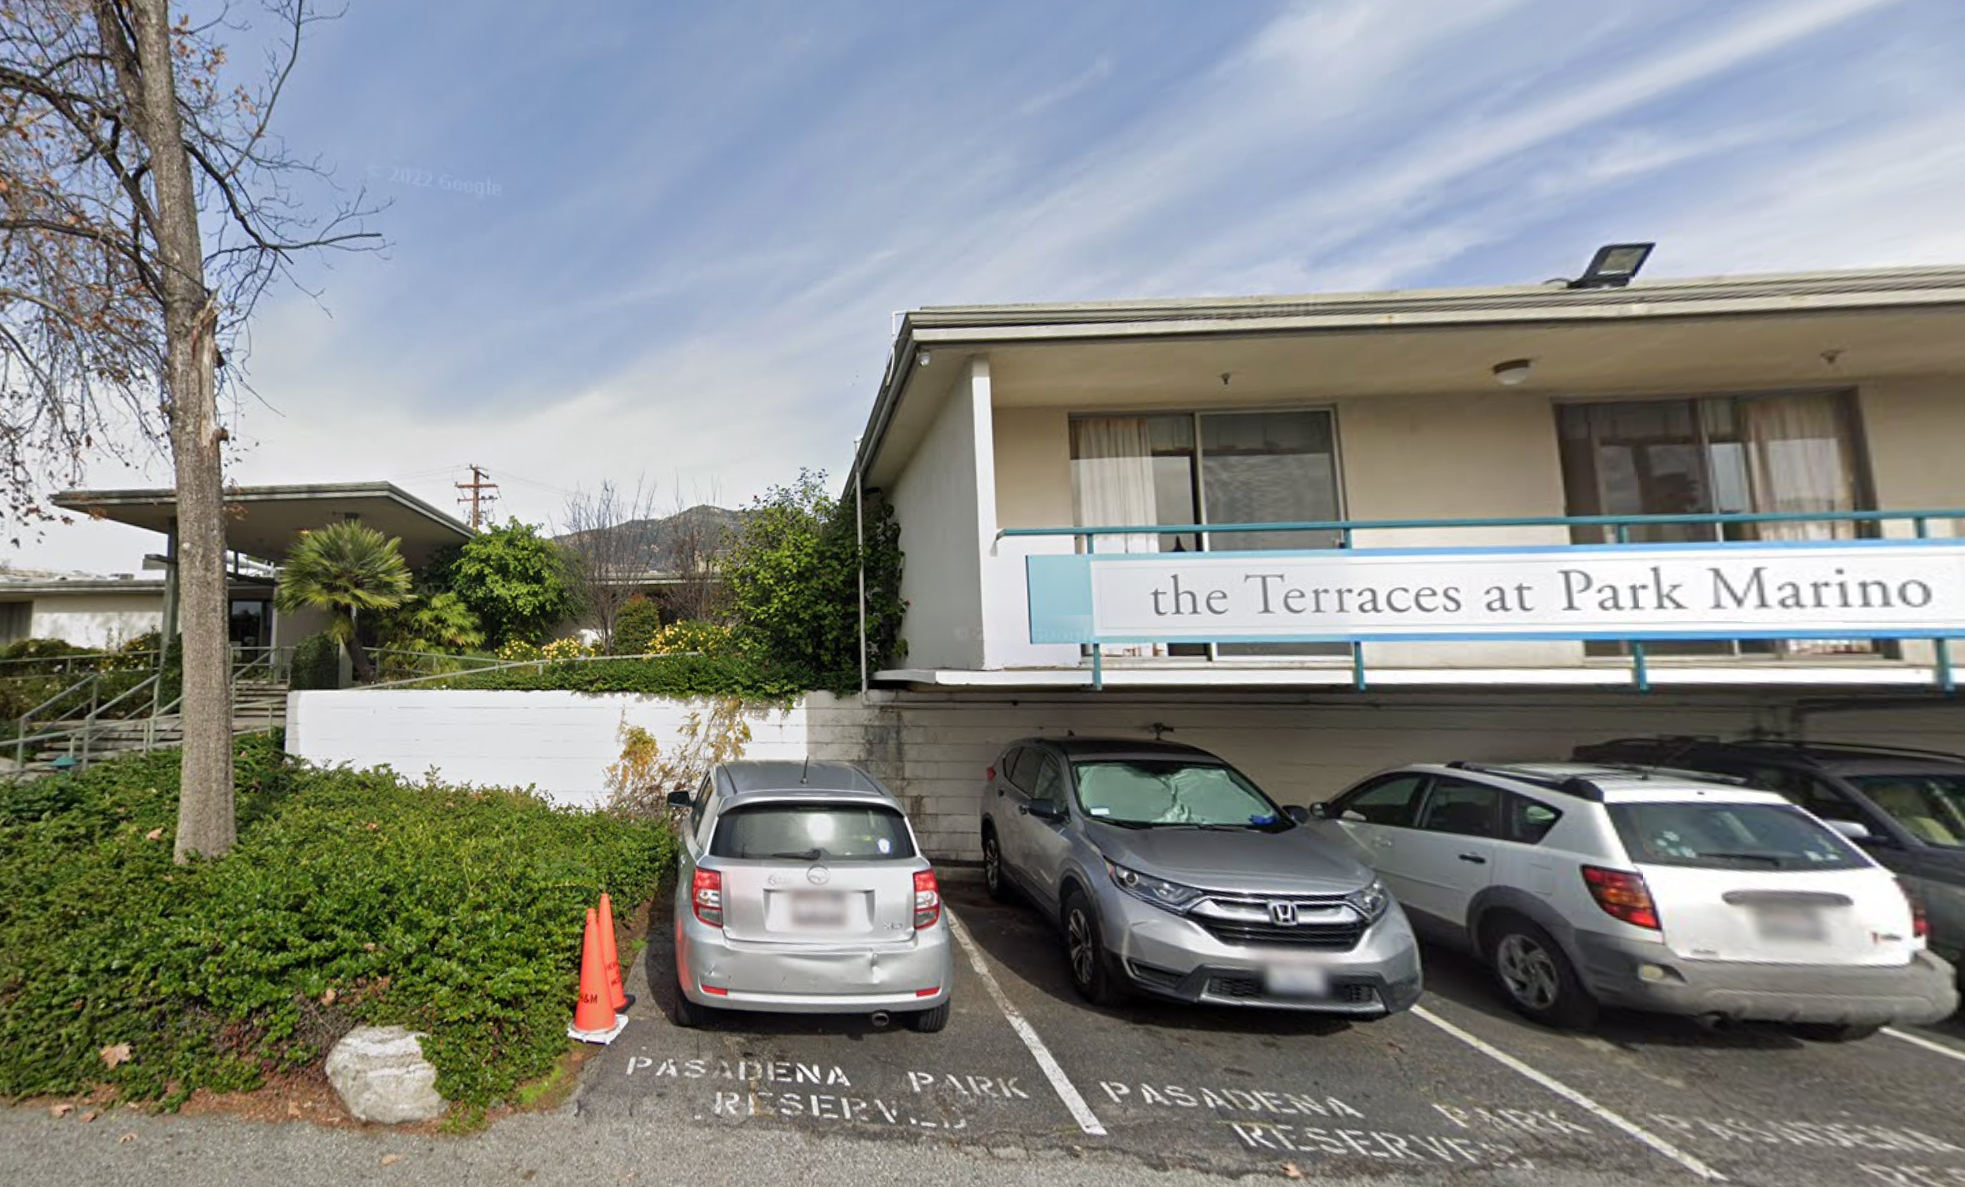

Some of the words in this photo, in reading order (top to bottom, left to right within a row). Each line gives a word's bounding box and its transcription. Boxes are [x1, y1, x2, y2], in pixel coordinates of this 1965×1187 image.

[1151, 574, 1228, 615] the
[1244, 573, 1462, 615] Terraces
[1484, 580, 1533, 612] at
[1558, 566, 1689, 612] Park
[1706, 566, 1932, 611] Marino
[625, 1055, 852, 1087] PASADENA
[907, 1070, 1031, 1100] PARK
[1100, 1081, 1366, 1119] PASADENA
